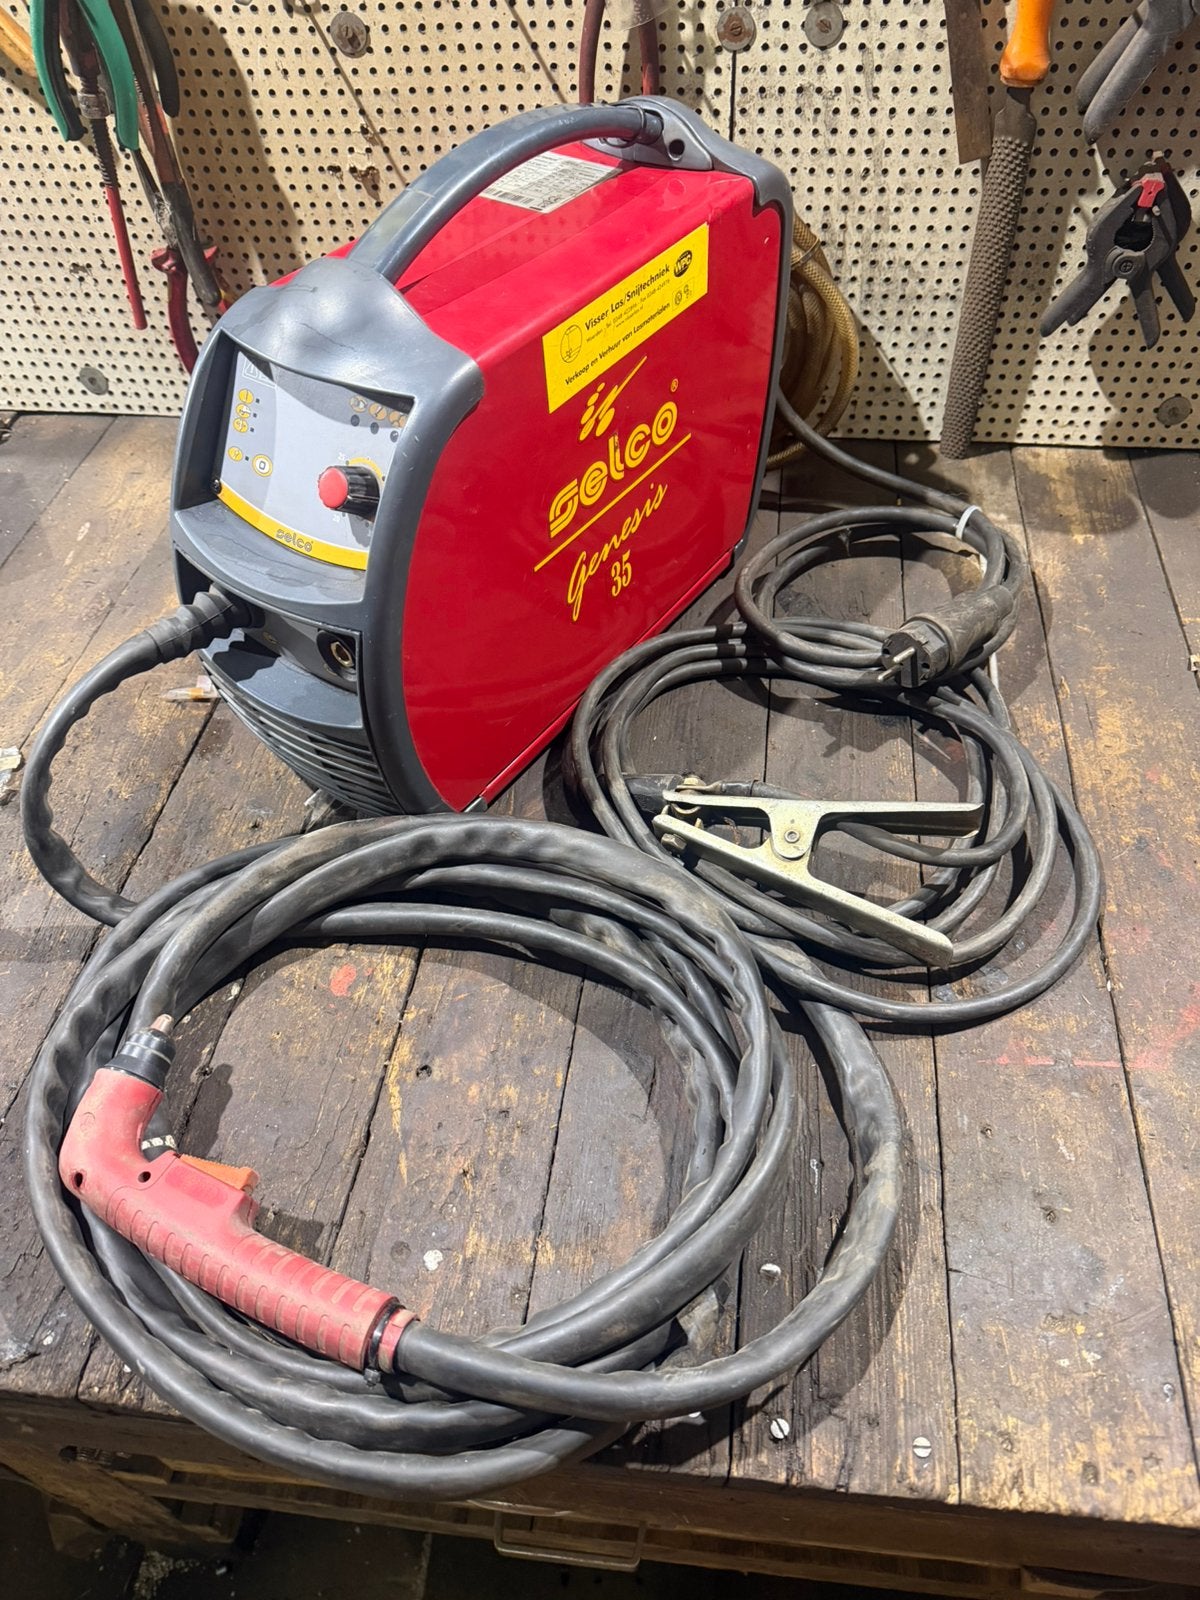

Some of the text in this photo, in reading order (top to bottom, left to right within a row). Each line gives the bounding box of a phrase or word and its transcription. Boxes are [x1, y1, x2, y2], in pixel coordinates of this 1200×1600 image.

[585, 309, 608, 330] Visser
[610, 264, 670, 313] Las/Snijtechniek
[565, 302, 671, 386] Verkoop en Verhuur van Lasmaterialen
[610, 549, 632, 598] 35
